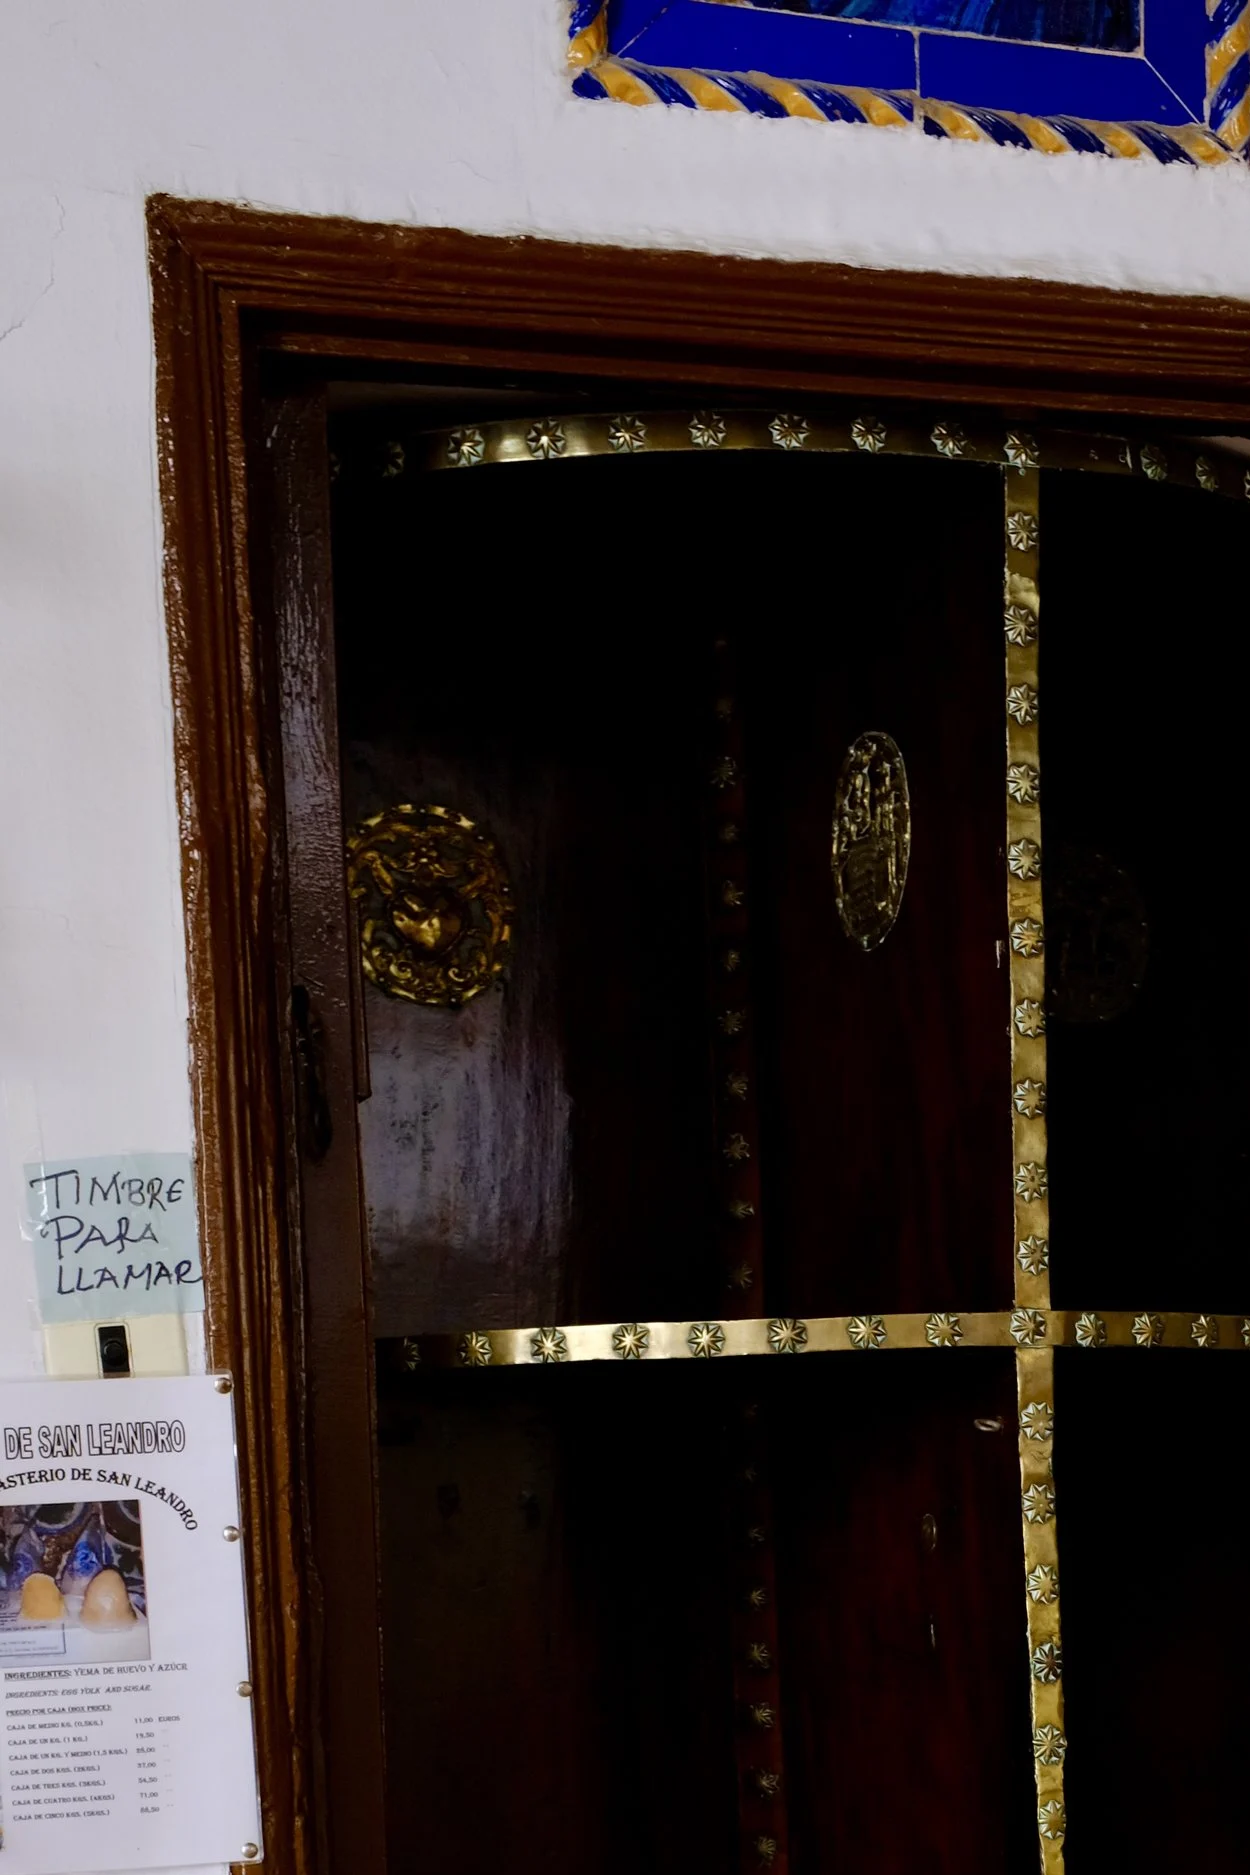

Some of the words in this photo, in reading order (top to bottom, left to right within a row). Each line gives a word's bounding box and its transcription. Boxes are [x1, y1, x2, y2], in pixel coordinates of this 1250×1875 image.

[29, 1169, 185, 1211] TIMBRE
[40, 1215, 159, 1260] PARA
[57, 1259, 204, 1295] LLAMAR
[3, 1426, 33, 1460] DE
[38, 1424, 82, 1459] SAN
[87, 1419, 186, 1456] LEANDRO
[71, 1468, 92, 1481] DE
[96, 1469, 132, 1487] SAN
[134, 1477, 198, 1531] LEANDRO
[103, 1667, 115, 1675] DE
[148, 1663, 155, 1672] Y
